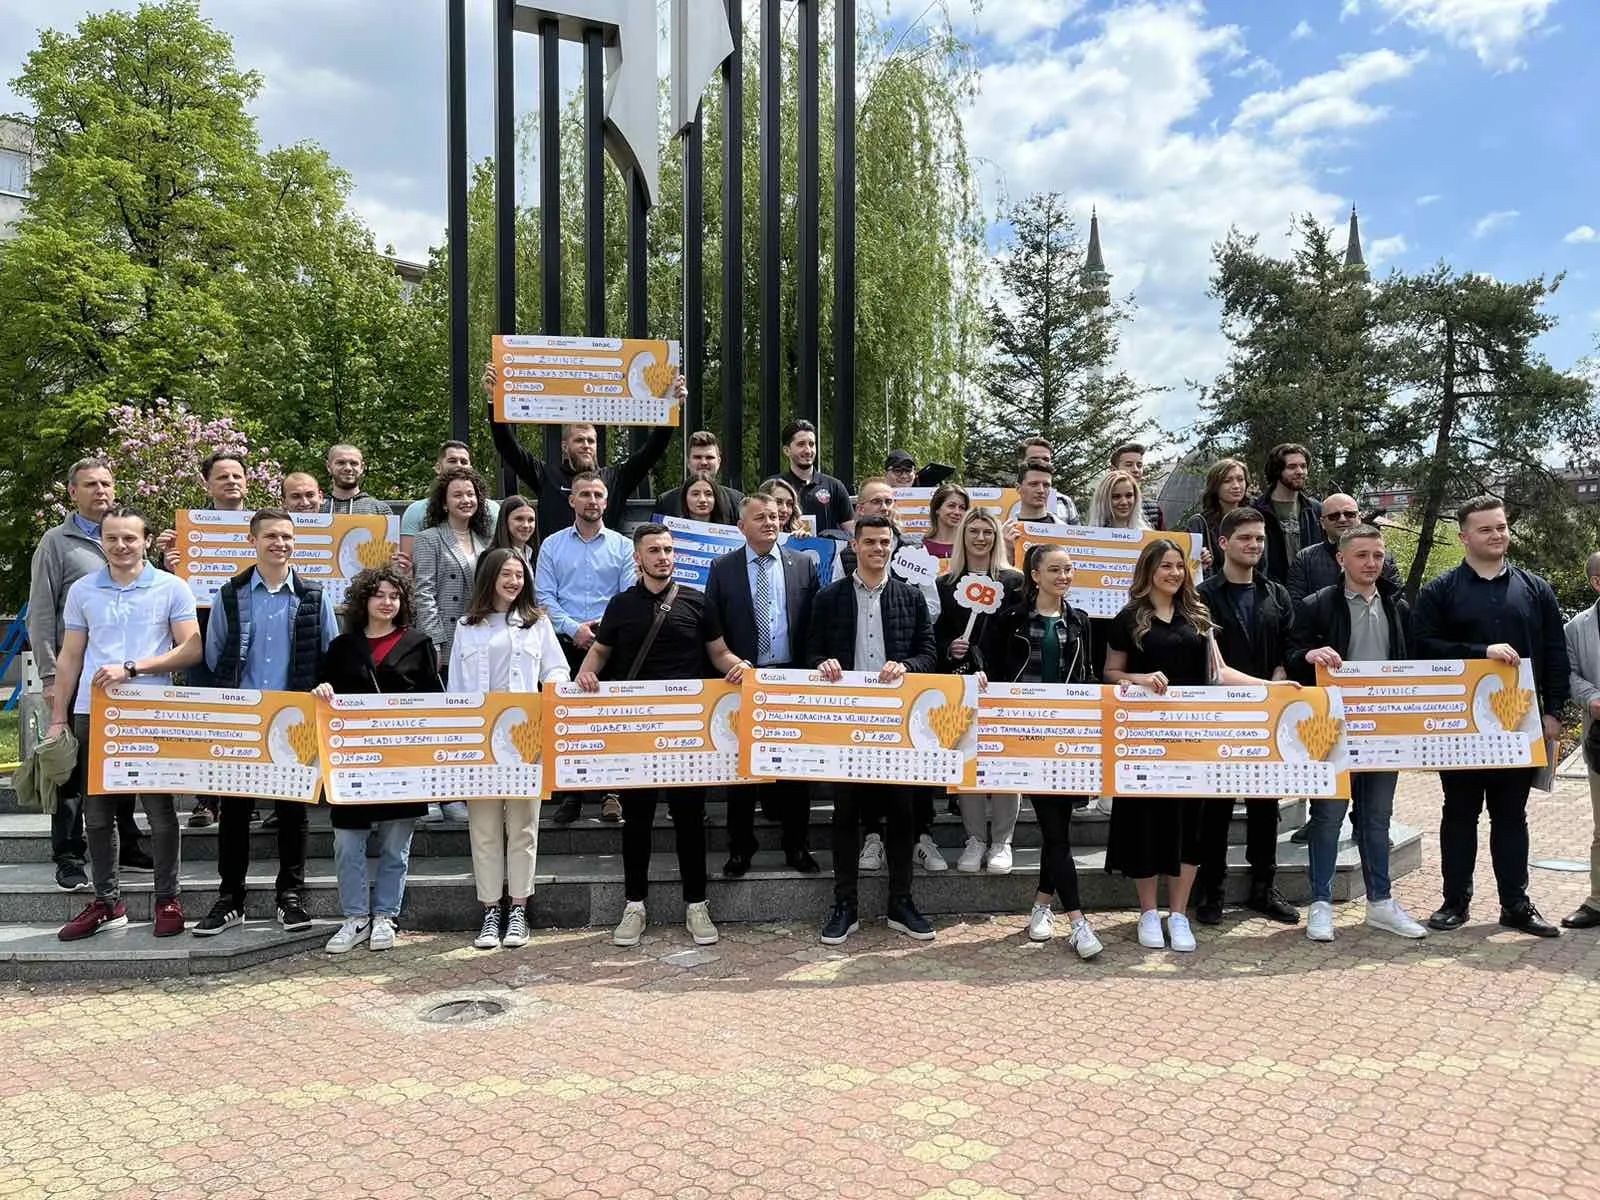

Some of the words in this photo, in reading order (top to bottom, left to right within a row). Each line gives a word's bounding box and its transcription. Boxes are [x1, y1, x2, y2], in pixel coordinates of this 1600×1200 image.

[1367, 686, 1419, 696] ŽIVINICE
[797, 695, 858, 706] ŽIVINICE
[154, 710, 210, 721] ŽIVINICE
[597, 706, 656, 716] ŽIVINICE
[996, 707, 1058, 718] ŽIVINICE
[1160, 711, 1224, 721] ŽIVINICE
[371, 719, 428, 728] ŽIVINICE
